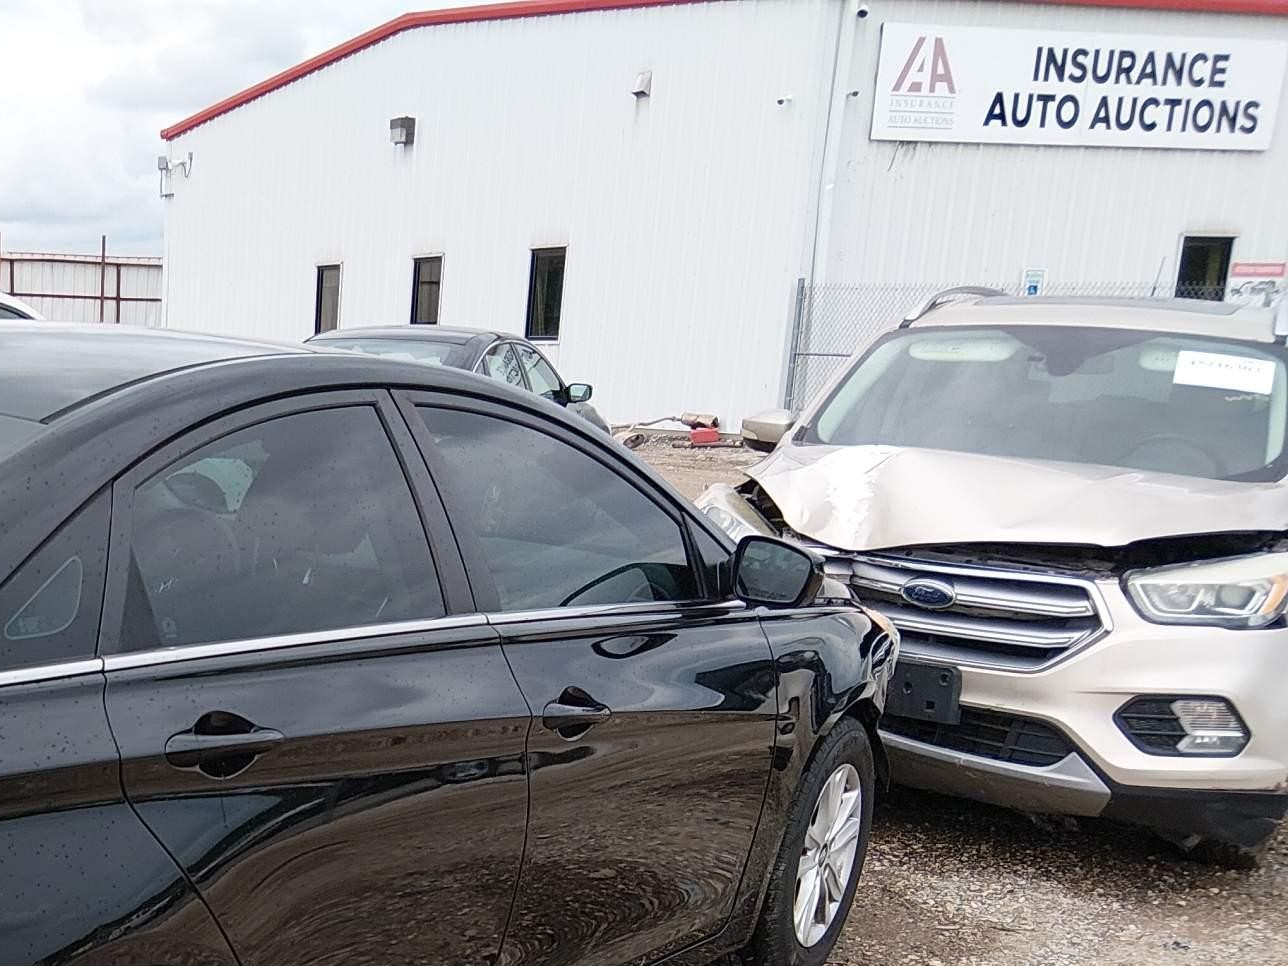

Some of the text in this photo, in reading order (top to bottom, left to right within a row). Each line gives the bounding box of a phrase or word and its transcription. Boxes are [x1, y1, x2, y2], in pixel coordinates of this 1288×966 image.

[1032, 46, 1231, 88] INSURANCE
[888, 97, 954, 109] INSURANCE
[982, 91, 1261, 135] AUTO AUCTIONS
[887, 115, 954, 126] AUTO AUCTIONS
